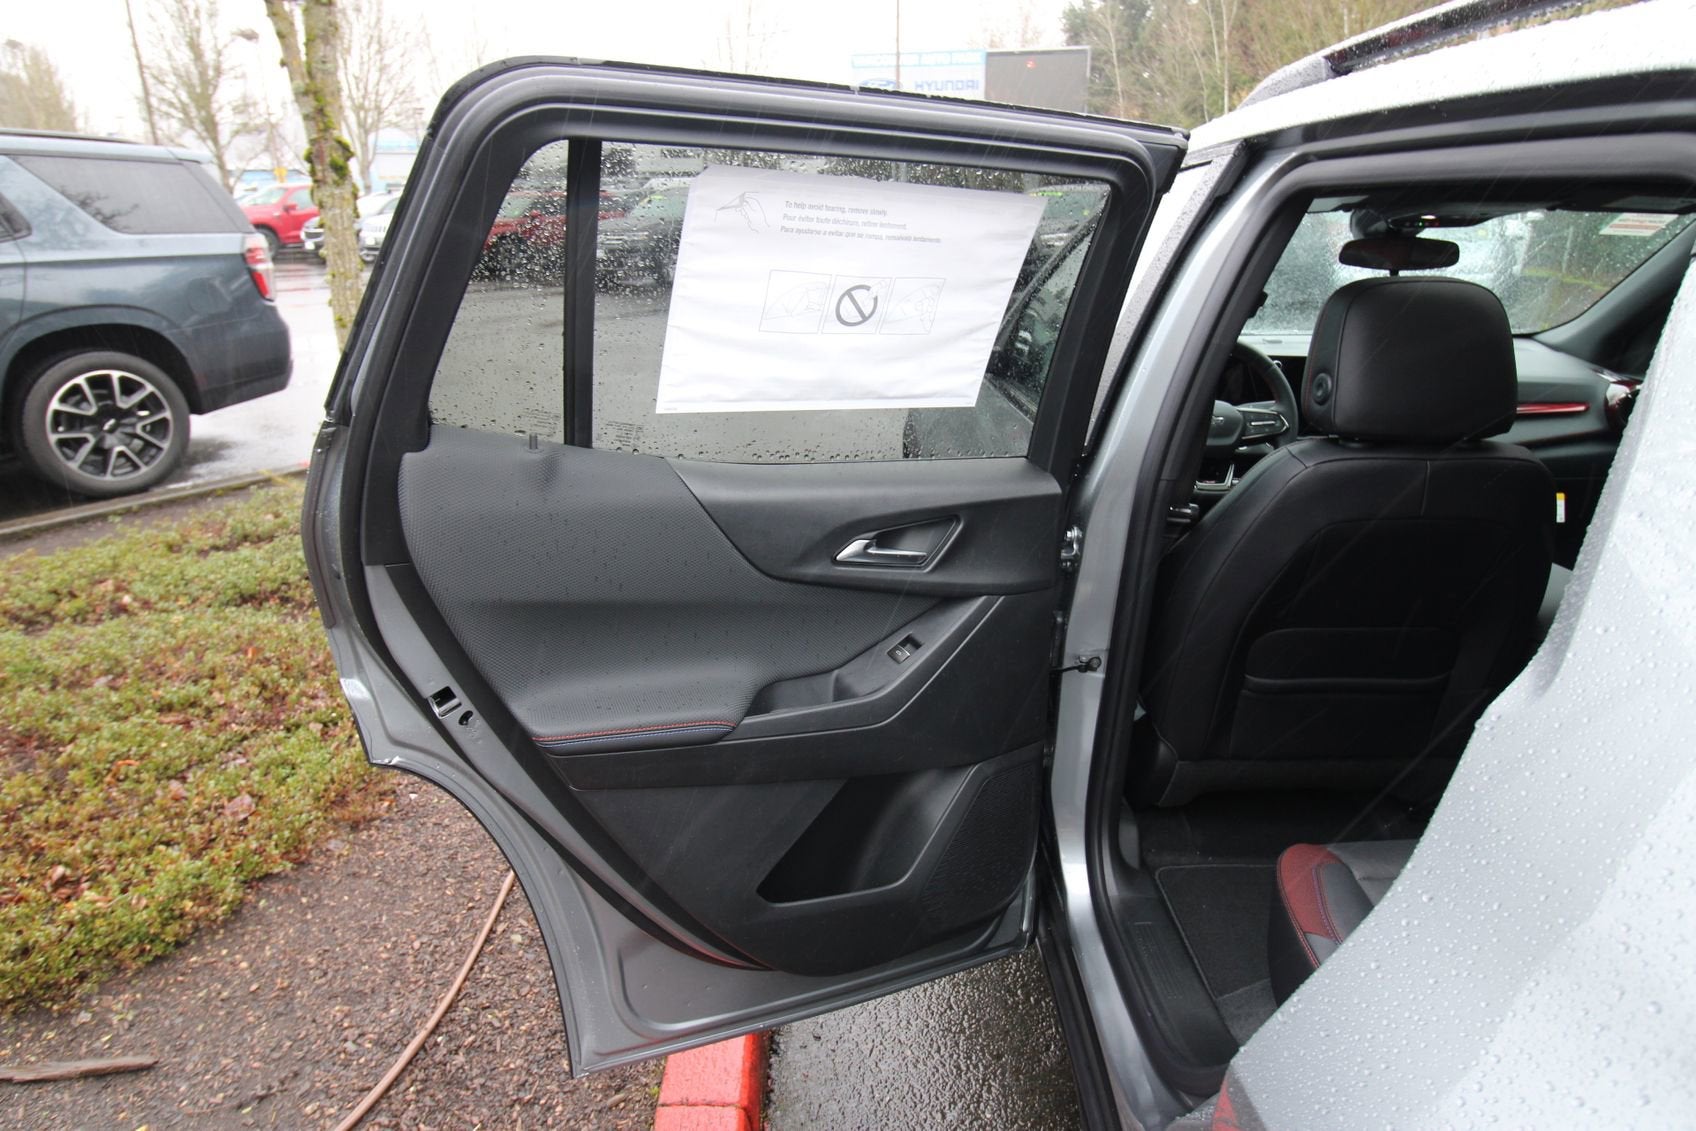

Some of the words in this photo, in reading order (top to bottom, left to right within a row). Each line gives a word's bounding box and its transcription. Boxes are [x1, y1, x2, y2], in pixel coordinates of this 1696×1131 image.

[915, 79, 980, 92] HYUNDAI
[785, 200, 793, 209] To
[794, 201, 806, 210] help
[848, 207, 868, 215] remove
[783, 213, 797, 221] Pour
[780, 225, 794, 233] Para
